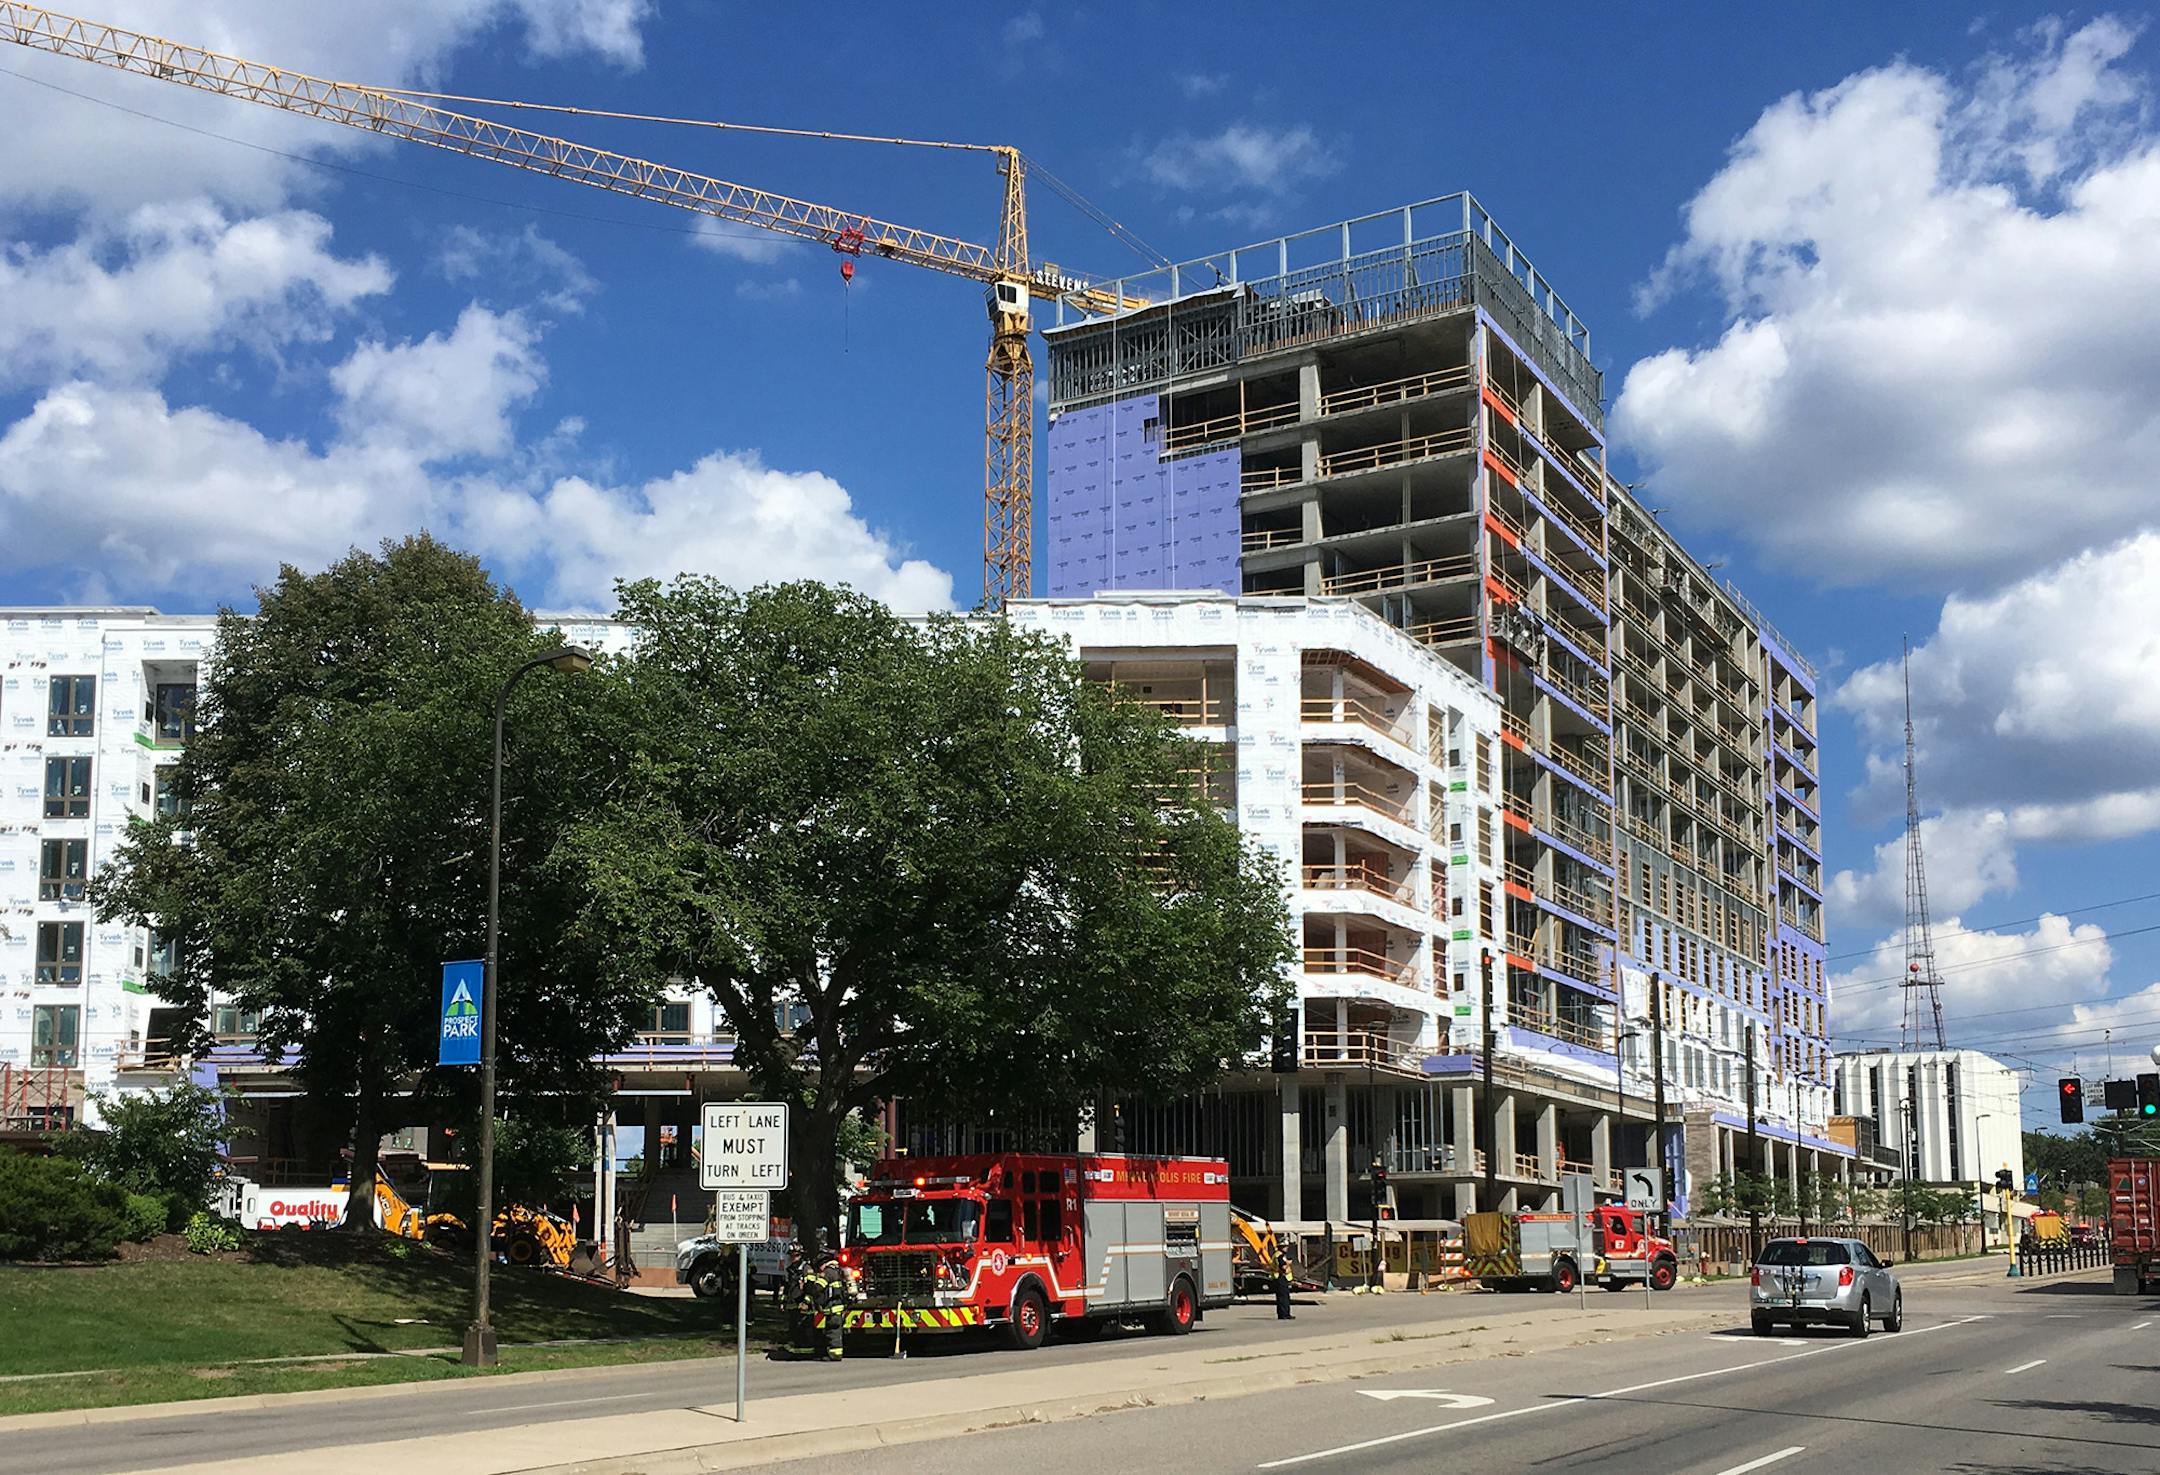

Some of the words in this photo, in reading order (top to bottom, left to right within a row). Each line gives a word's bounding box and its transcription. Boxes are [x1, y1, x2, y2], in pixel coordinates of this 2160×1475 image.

[1036, 270, 1089, 291] STEVENS
[1099, 609, 1121, 617] Tyvek
[1247, 808, 1269, 816] Tyvek
[100, 933, 121, 941] Tyvek
[444, 1015, 478, 1024] PROSPECT
[443, 1023, 478, 1037] PARK
[711, 1115, 740, 1128] LEFT
[749, 1115, 780, 1128] LANE
[723, 1139, 765, 1154] MUST
[707, 1165, 739, 1177] TURN
[752, 1165, 781, 1177] LEFT
[1183, 1172, 1201, 1183] FIRE
[270, 1200, 339, 1218] Quality
[722, 1202, 764, 1212] EXEMPT
[1066, 1198, 1078, 1211] R1
[1631, 1199, 1657, 1208] ONLY
[1615, 1240, 1625, 1249] E7
